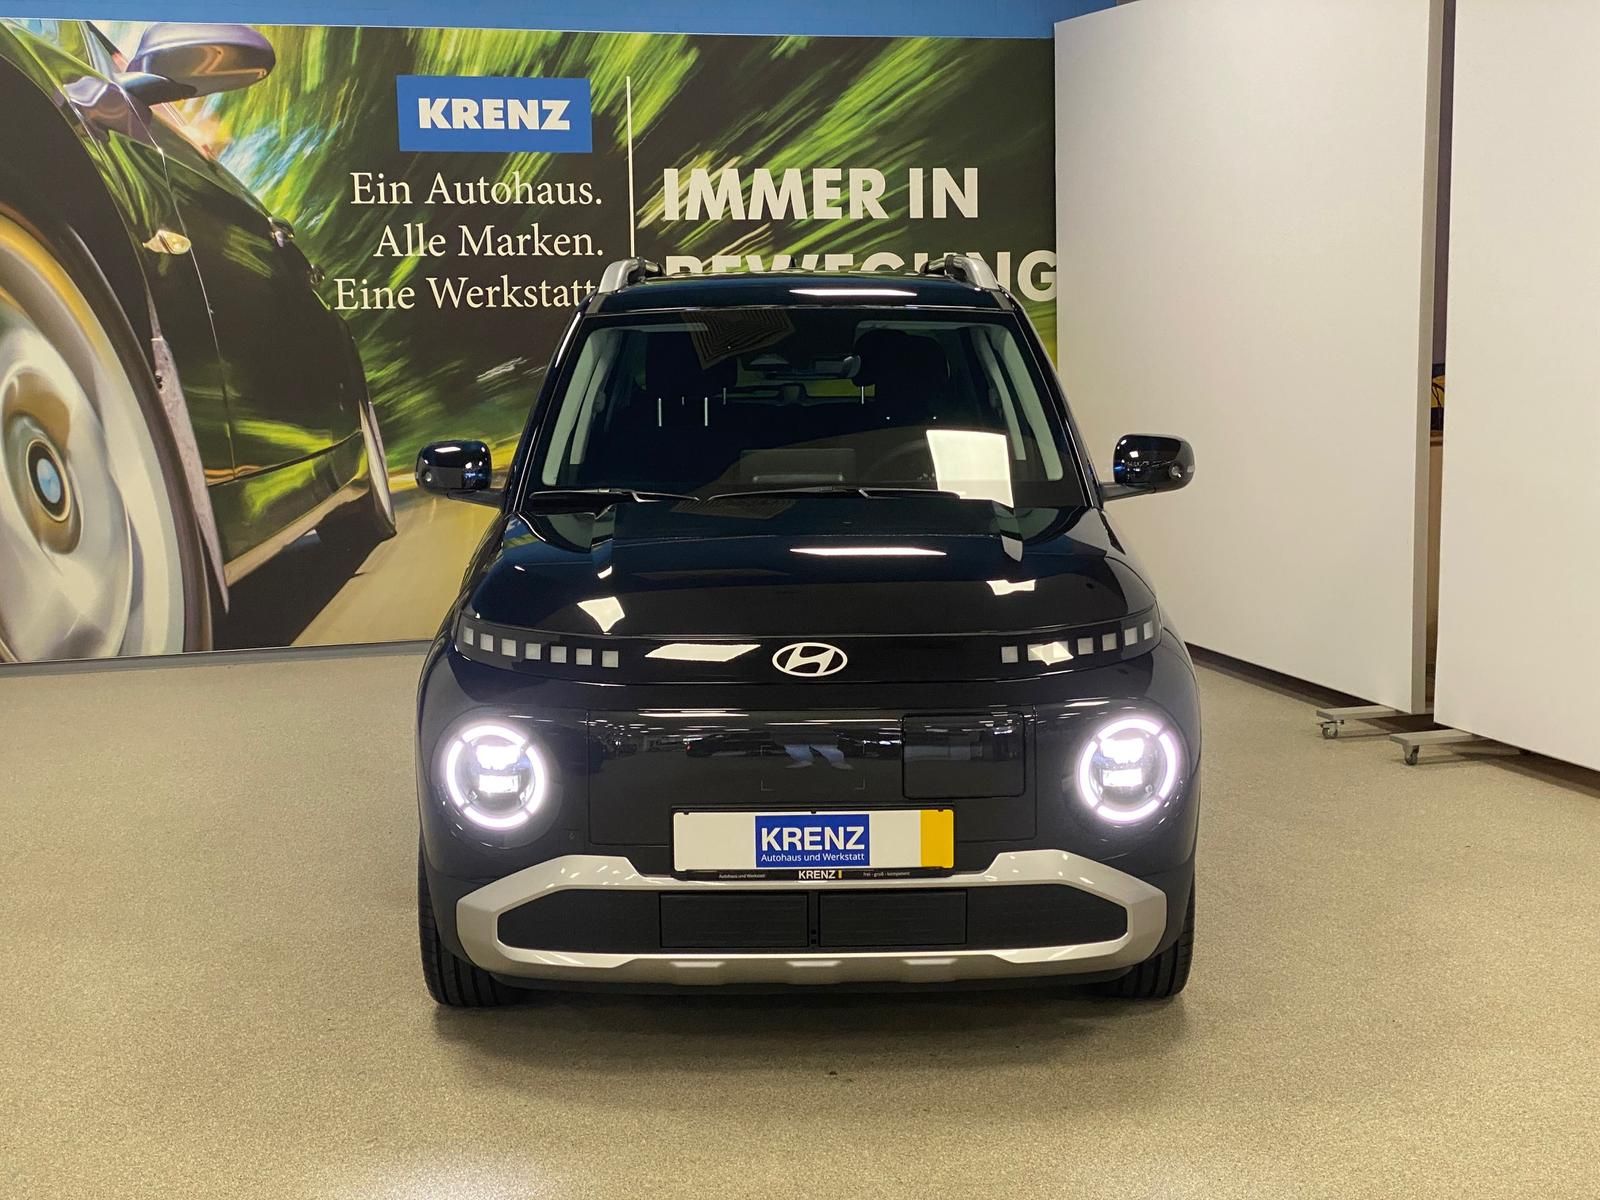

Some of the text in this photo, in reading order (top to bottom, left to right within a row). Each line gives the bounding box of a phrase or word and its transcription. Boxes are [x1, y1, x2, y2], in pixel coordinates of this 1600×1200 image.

[417, 97, 571, 131] KRENZ
[350, 170, 602, 206] Ein Autohaus.
[662, 166, 980, 221] IMMER IN
[372, 221, 604, 258] Alle Marken.
[333, 277, 416, 311] Eine
[761, 826, 866, 852] KRENZ
[760, 851, 866, 863] Autohaus und Werkstatt
[798, 869, 837, 880] KRENZ
